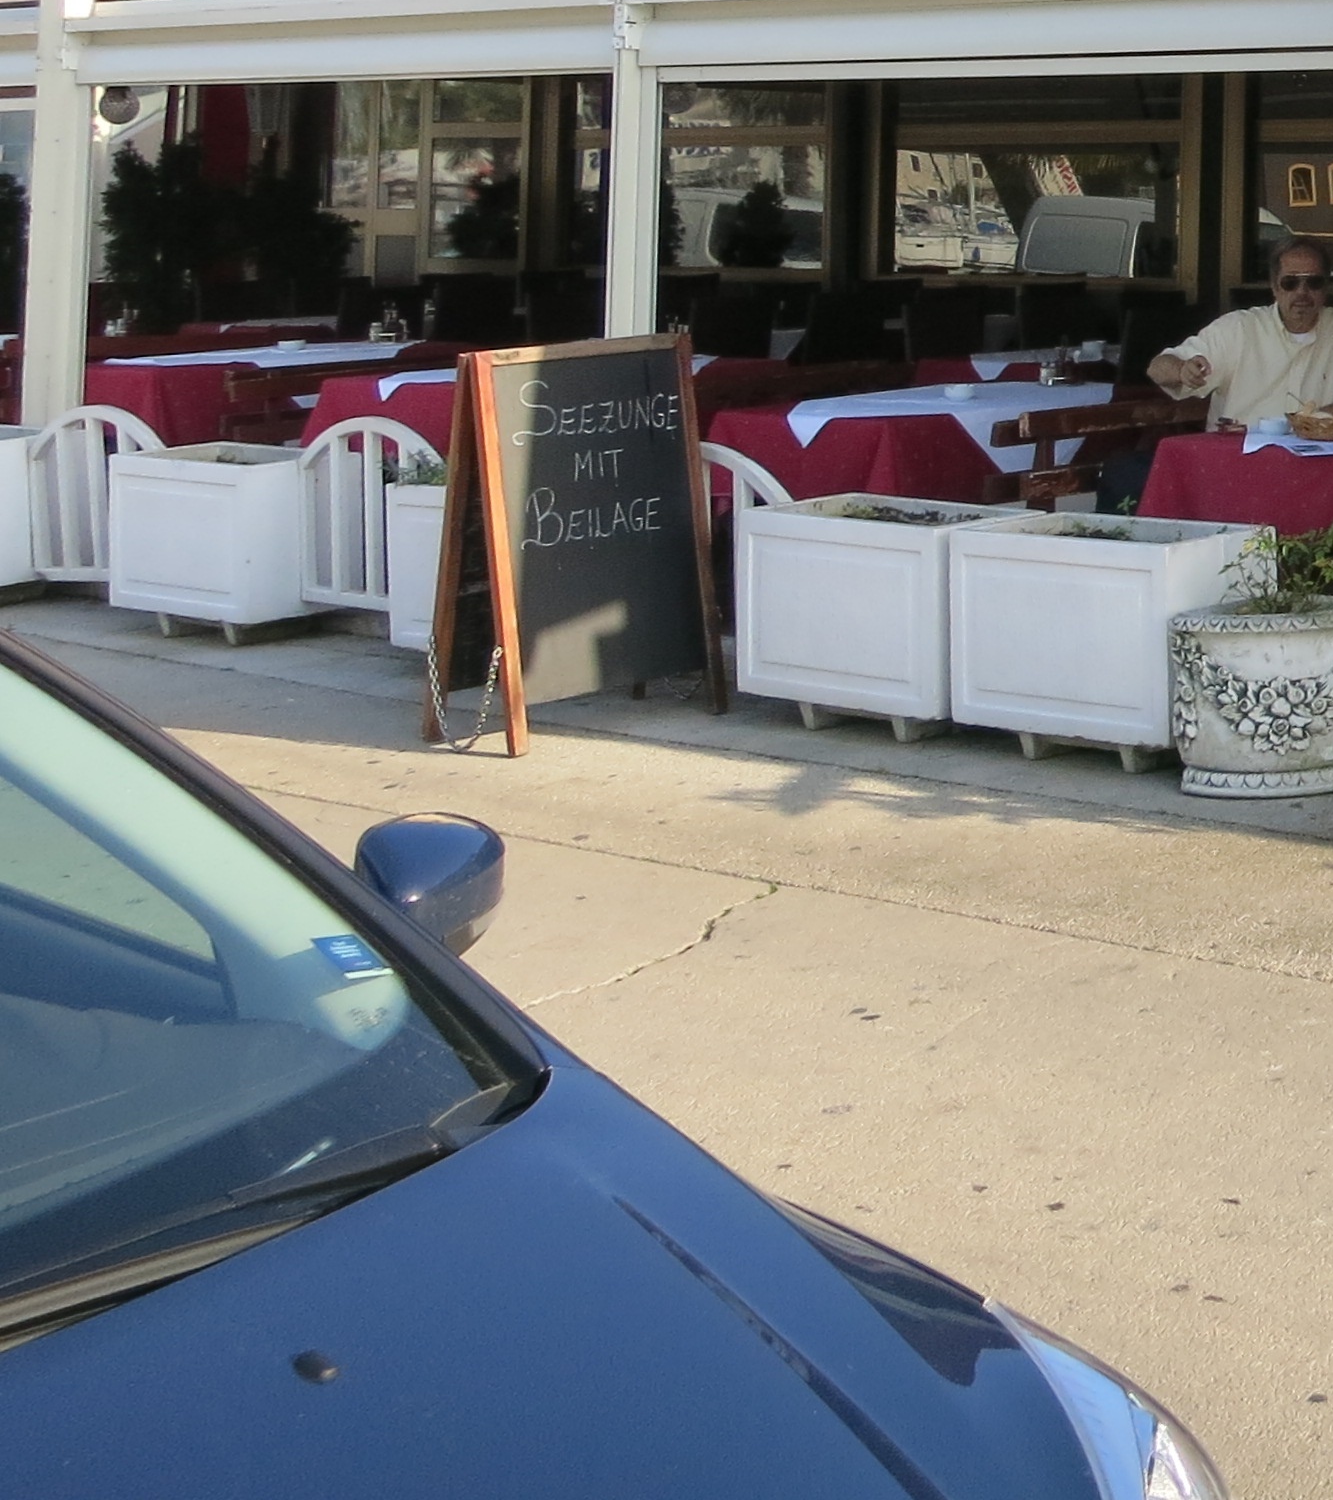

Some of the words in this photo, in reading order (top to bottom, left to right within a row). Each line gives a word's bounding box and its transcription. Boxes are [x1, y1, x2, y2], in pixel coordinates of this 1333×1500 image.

[512, 379, 680, 446] SEEZUNGE
[573, 448, 625, 483] MIT
[521, 486, 662, 551] BEILAGE
